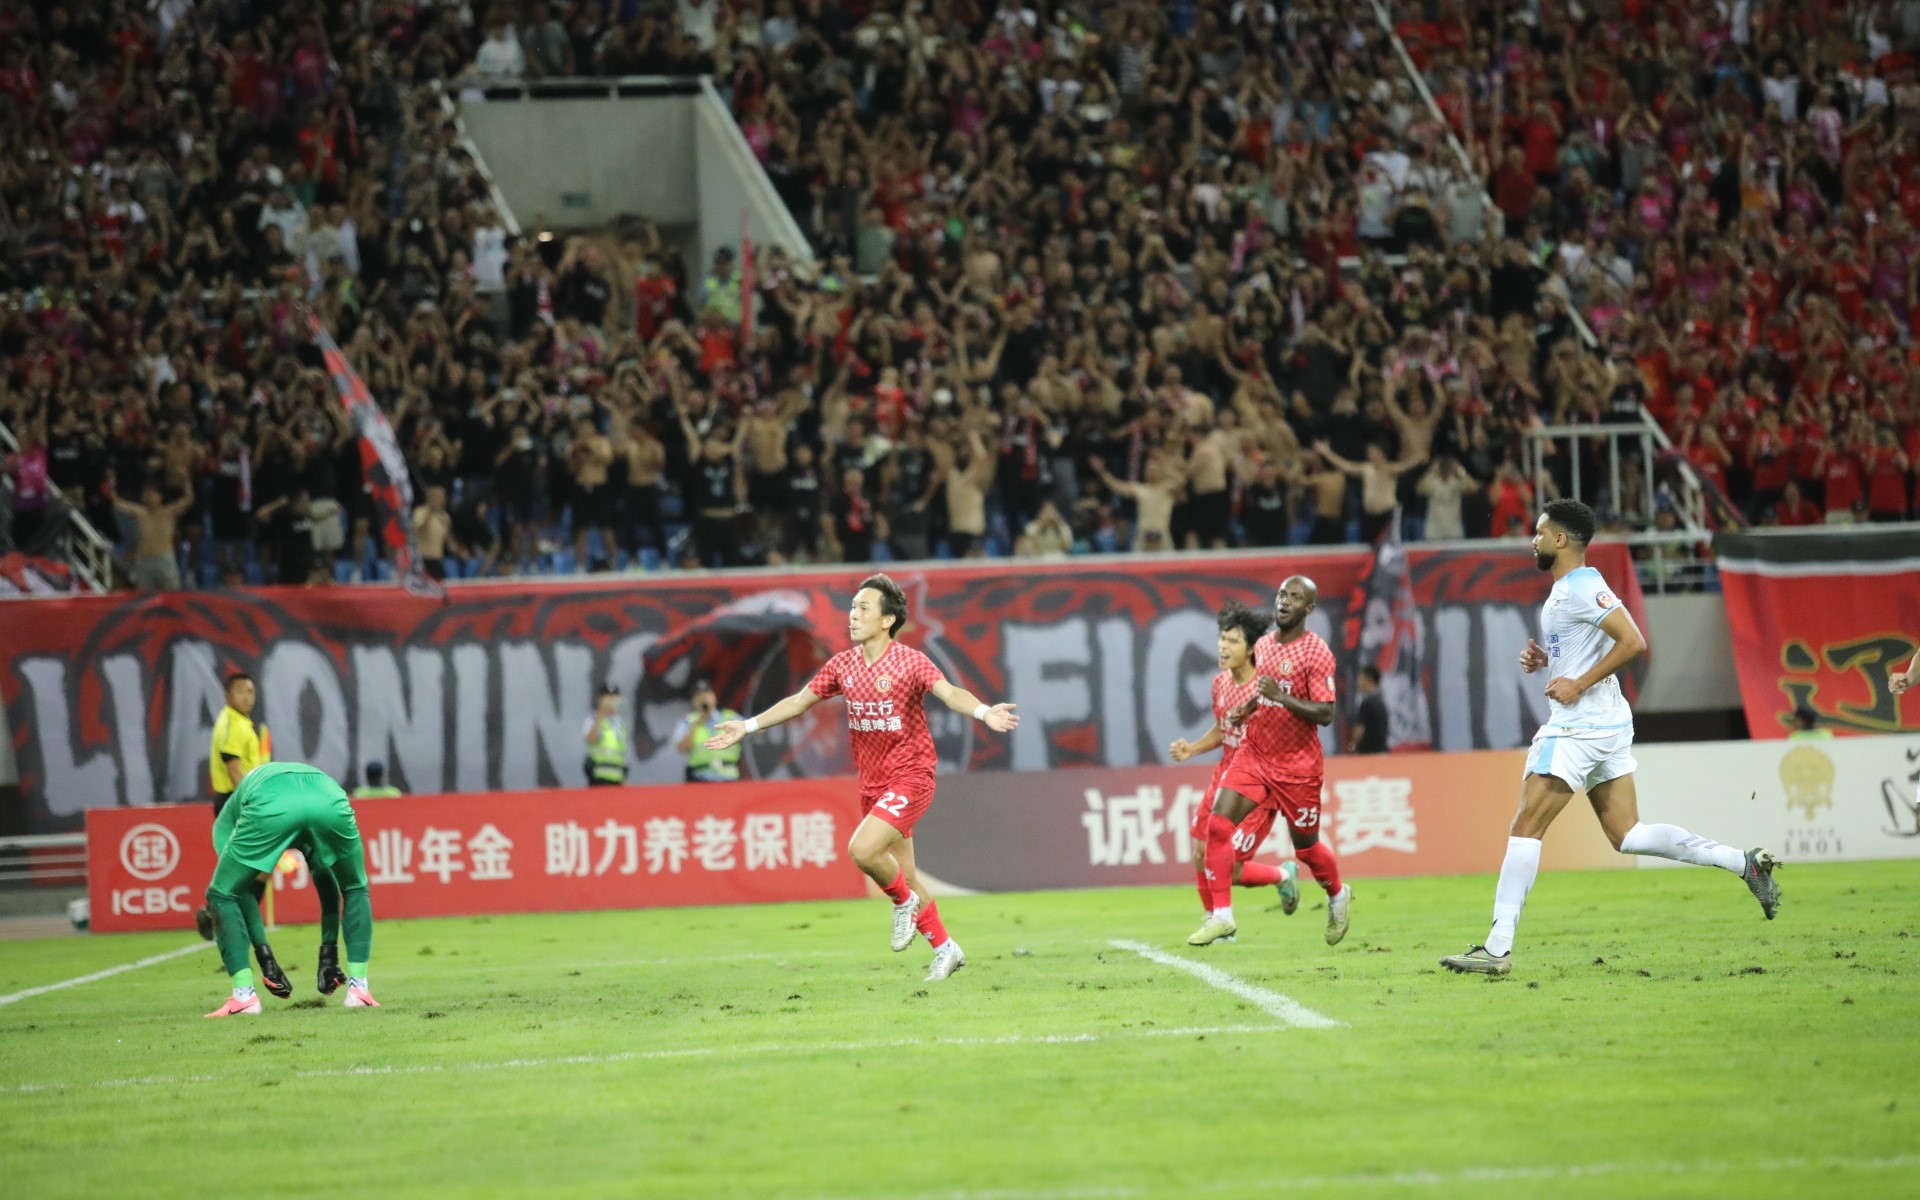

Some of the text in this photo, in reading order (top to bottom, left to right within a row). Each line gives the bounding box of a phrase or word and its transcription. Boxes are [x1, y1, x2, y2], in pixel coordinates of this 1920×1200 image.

[876, 791, 909, 817] 22
[544, 811, 838, 878] 助力养老保障
[1231, 828, 1256, 853] 40
[112, 886, 190, 915] ICBC
